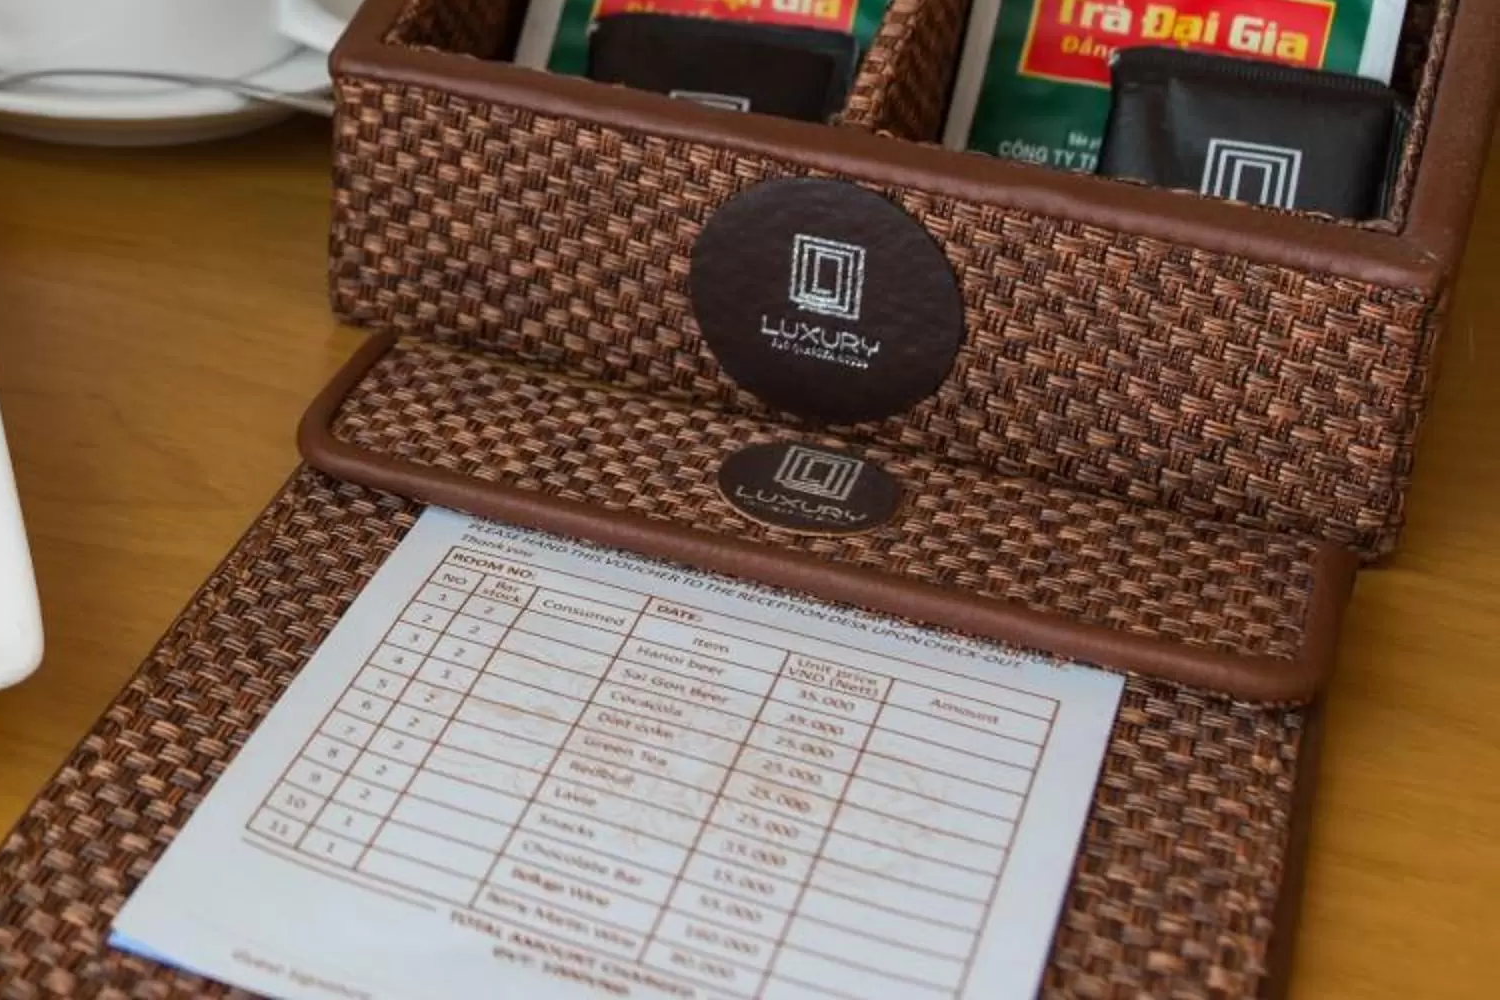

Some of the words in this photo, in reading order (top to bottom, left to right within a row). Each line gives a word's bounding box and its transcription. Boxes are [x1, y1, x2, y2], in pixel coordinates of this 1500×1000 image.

[1141, 3, 1221, 49] Đại
[1228, 15, 1311, 62] Gia
[1053, 149, 1075, 167] TY
[761, 314, 881, 357] LUXURY
[736, 485, 868, 521] LUXURY
[453, 553, 504, 570] ROOM
[443, 574, 467, 584] NO
[496, 582, 519, 591] Bar
[482, 588, 521, 601] stock
[693, 638, 729, 652] Item
[789, 668, 824, 682] VND
[797, 660, 830, 673] Unit
[835, 670, 877, 687] price
[929, 698, 1000, 724] Amount
